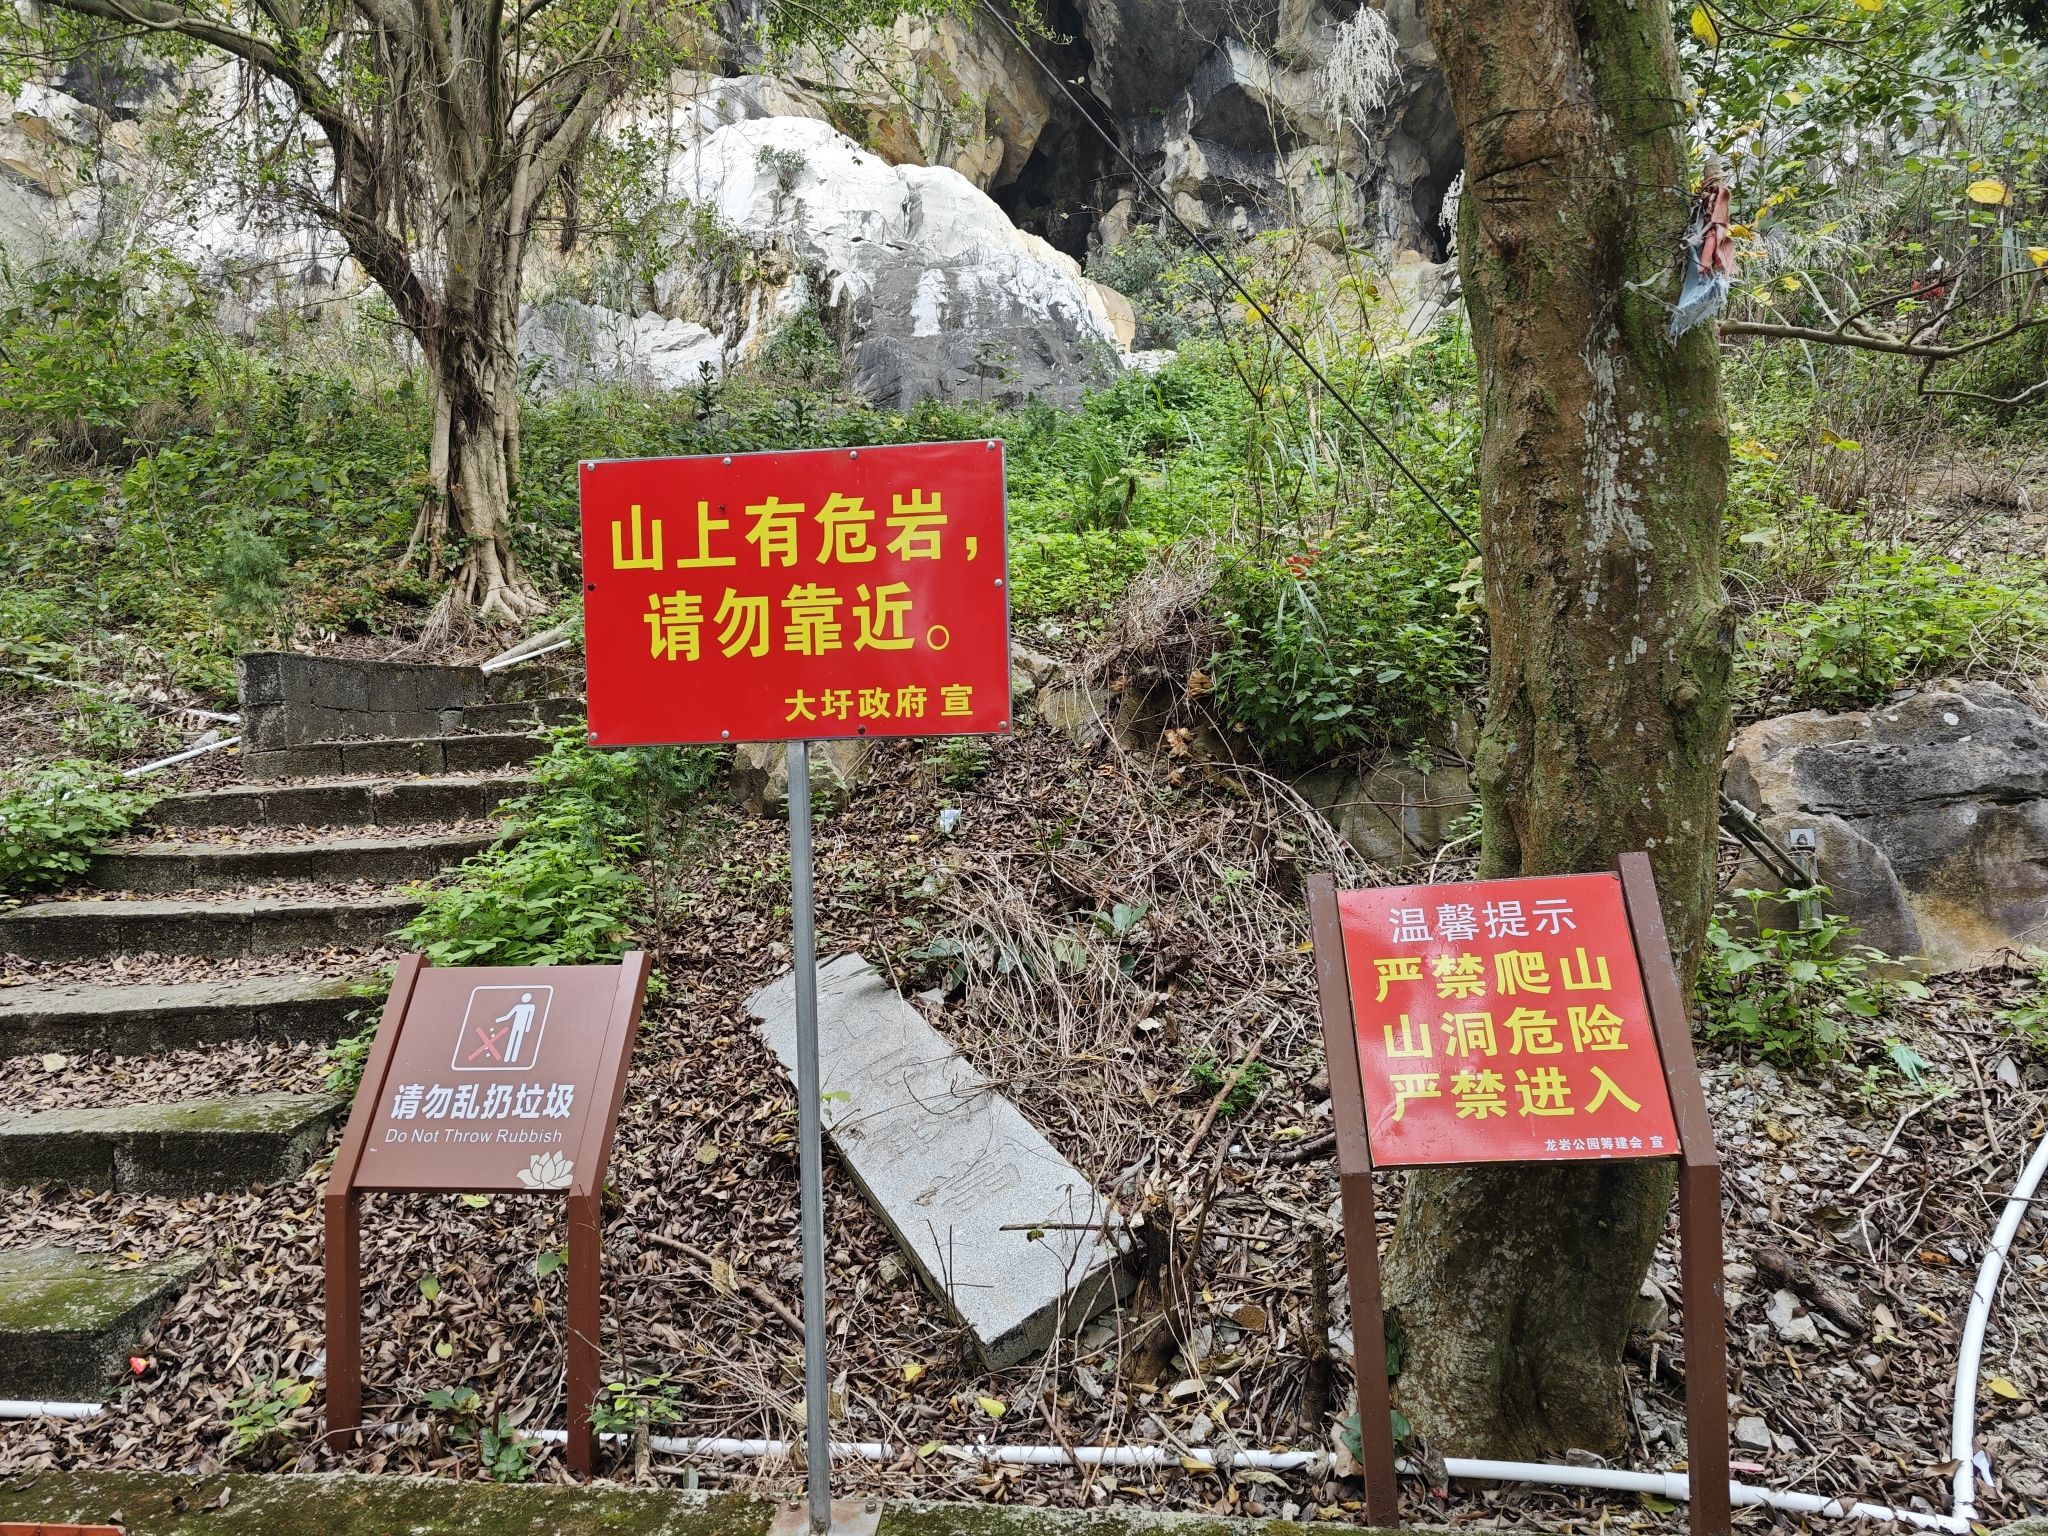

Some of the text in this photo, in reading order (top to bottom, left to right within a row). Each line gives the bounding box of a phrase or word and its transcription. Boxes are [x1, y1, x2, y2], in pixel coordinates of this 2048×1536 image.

[784, 683, 974, 722] 大圩政府 宣
[1388, 898, 1577, 944] 温馨提示
[1372, 947, 1612, 1002] 严禁爬山
[1382, 1004, 1629, 1059] 山洞危险
[390, 1083, 575, 1120] 请勿乱扔垃圾
[1390, 1066, 1642, 1122] 严禁进入
[385, 1129, 562, 1143] Do Not Throw Rubbish
[1544, 1135, 1664, 1152] 龙岩公园筹建会 宣
